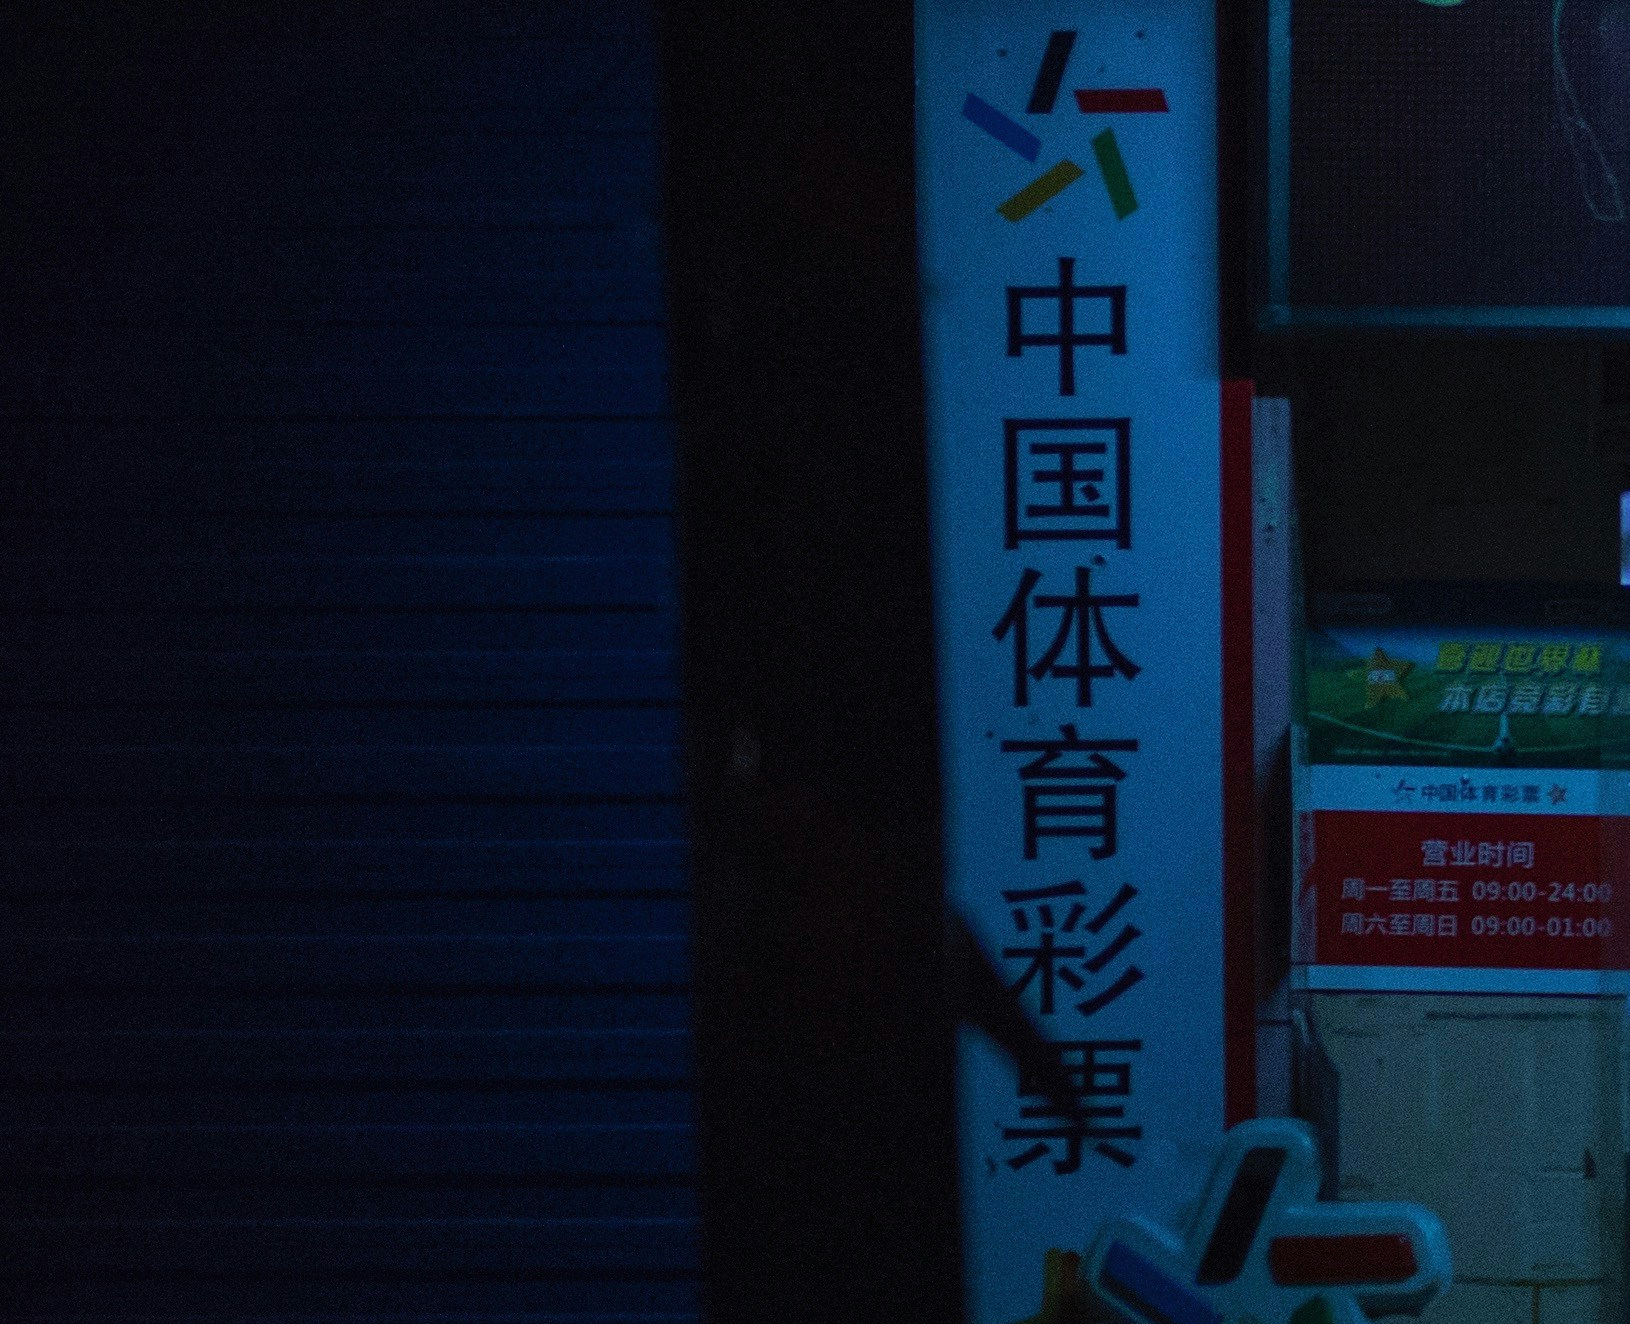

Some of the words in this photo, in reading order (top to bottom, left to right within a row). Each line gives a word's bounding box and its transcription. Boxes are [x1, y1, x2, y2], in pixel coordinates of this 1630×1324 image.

[992, 256, 1144, 1175] 中国体育彩票
[1420, 840, 1536, 869] 营业时间
[1340, 876, 1461, 903] 周一至周五
[1471, 880, 1613, 904] 09:00-24:00
[1340, 912, 1459, 937] 周六至周日
[1470, 916, 1613, 938] 09:00-01:00
